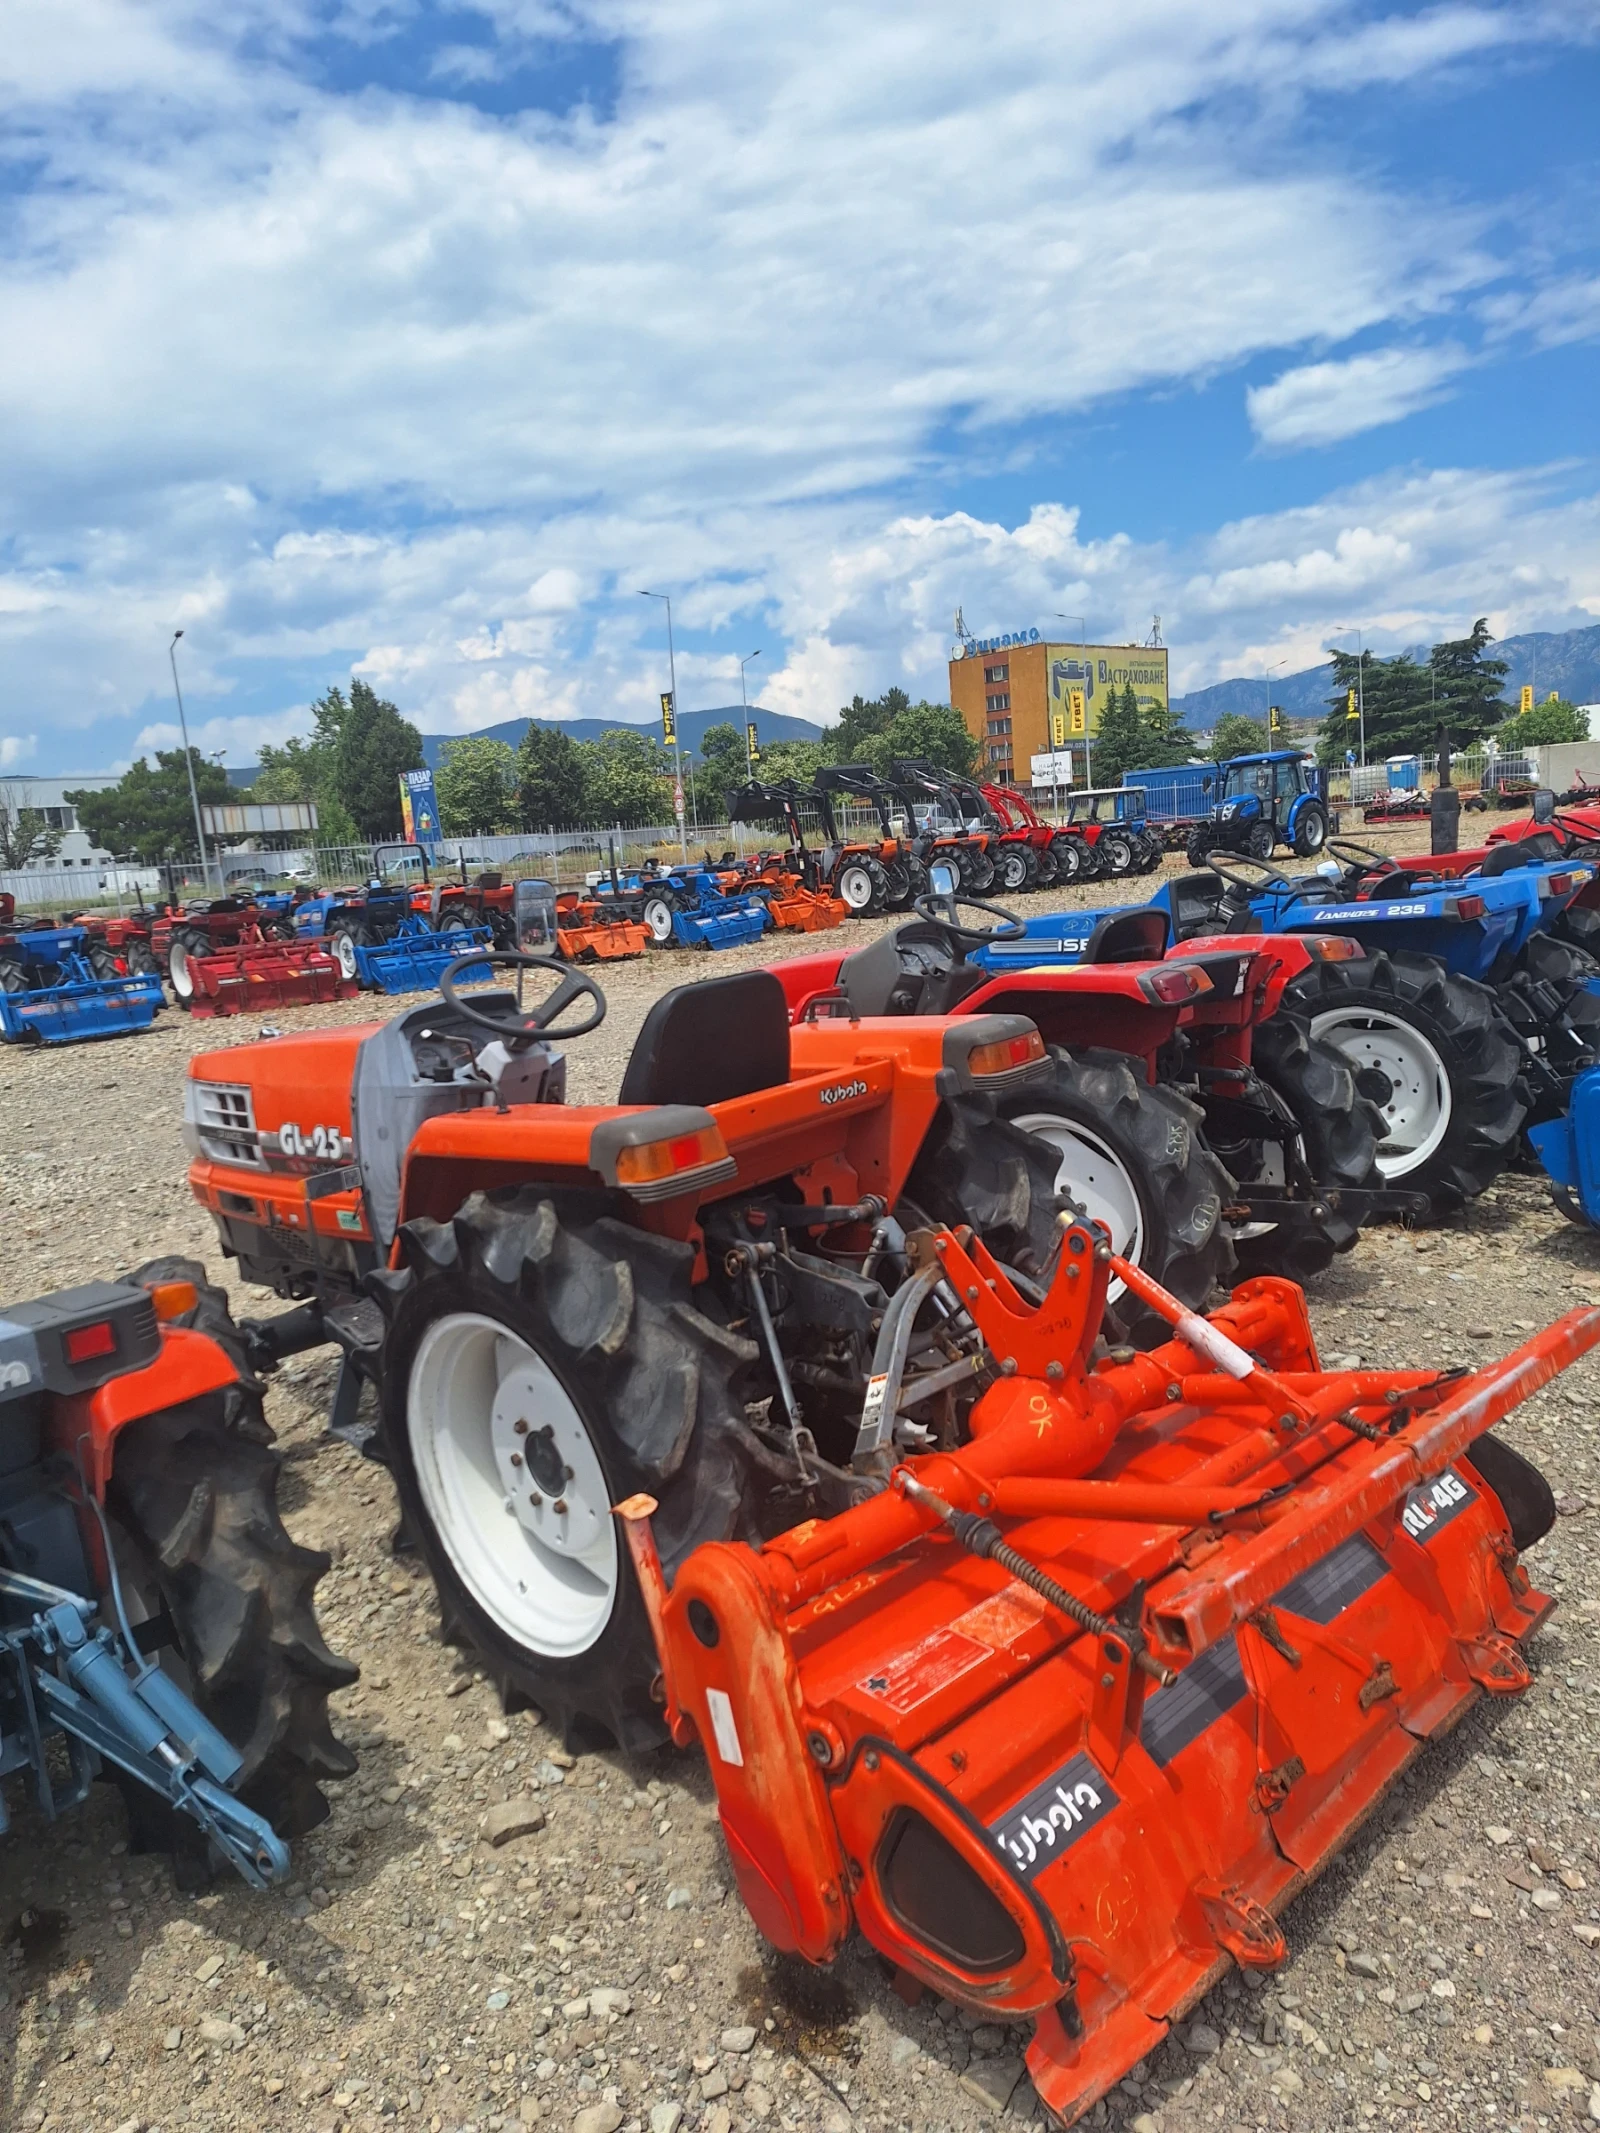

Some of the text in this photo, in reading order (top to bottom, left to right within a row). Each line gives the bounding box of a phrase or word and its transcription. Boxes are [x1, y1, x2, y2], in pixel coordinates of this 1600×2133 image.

[1073, 694, 1082, 729] EFBET
[408, 770, 431, 784] ПАЗАР
[1387, 904, 1426, 916] 235
[820, 1080, 868, 1105] Kubota
[279, 1122, 343, 1159] GL-25
